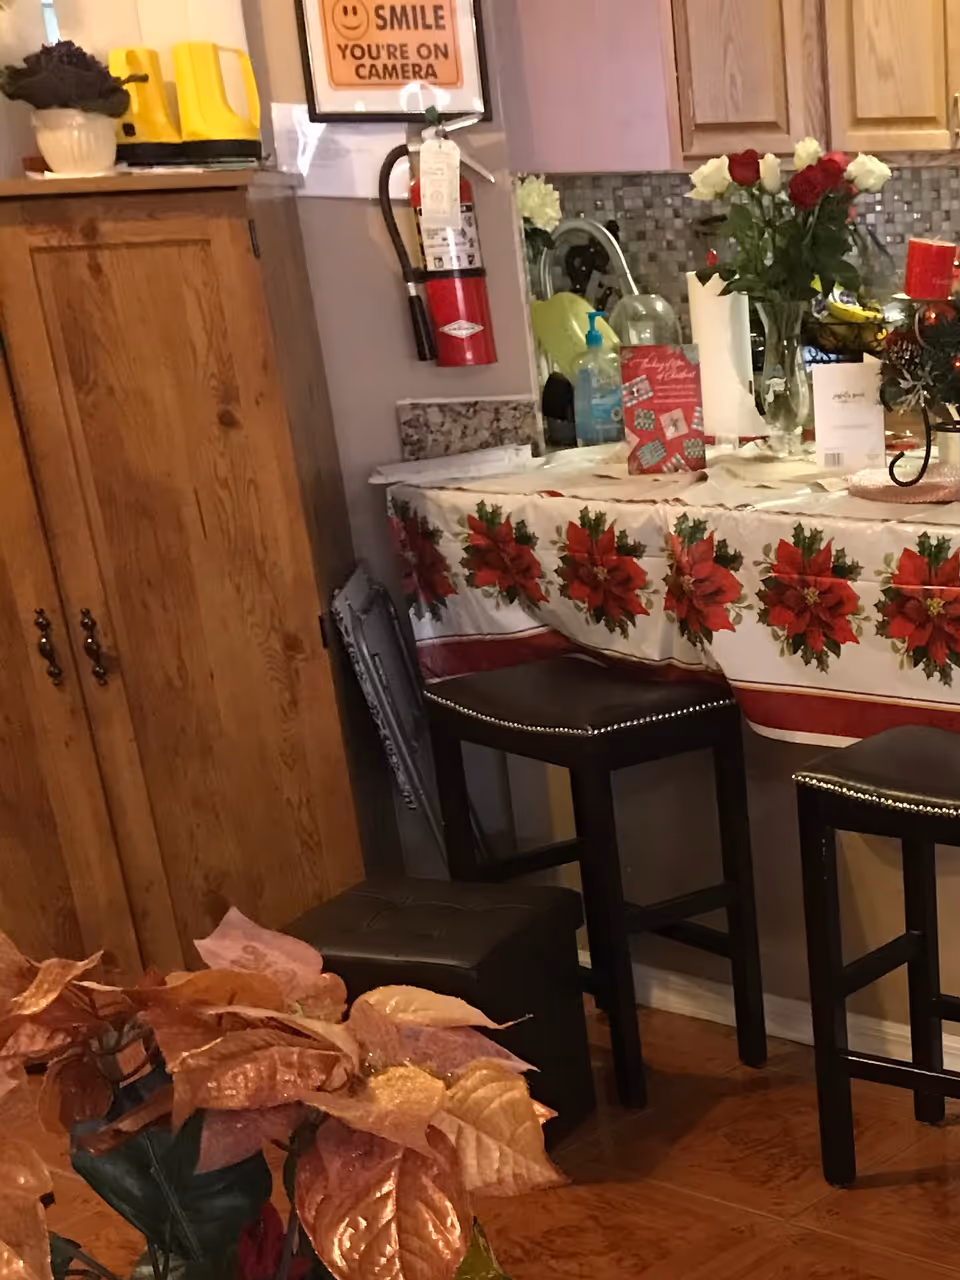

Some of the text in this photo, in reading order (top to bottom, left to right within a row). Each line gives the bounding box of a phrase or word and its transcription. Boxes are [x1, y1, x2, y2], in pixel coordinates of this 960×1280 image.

[374, 4, 446, 31] SMILE
[337, 42, 449, 61] YOU'RE ON
[354, 63, 438, 80] CAMERA
